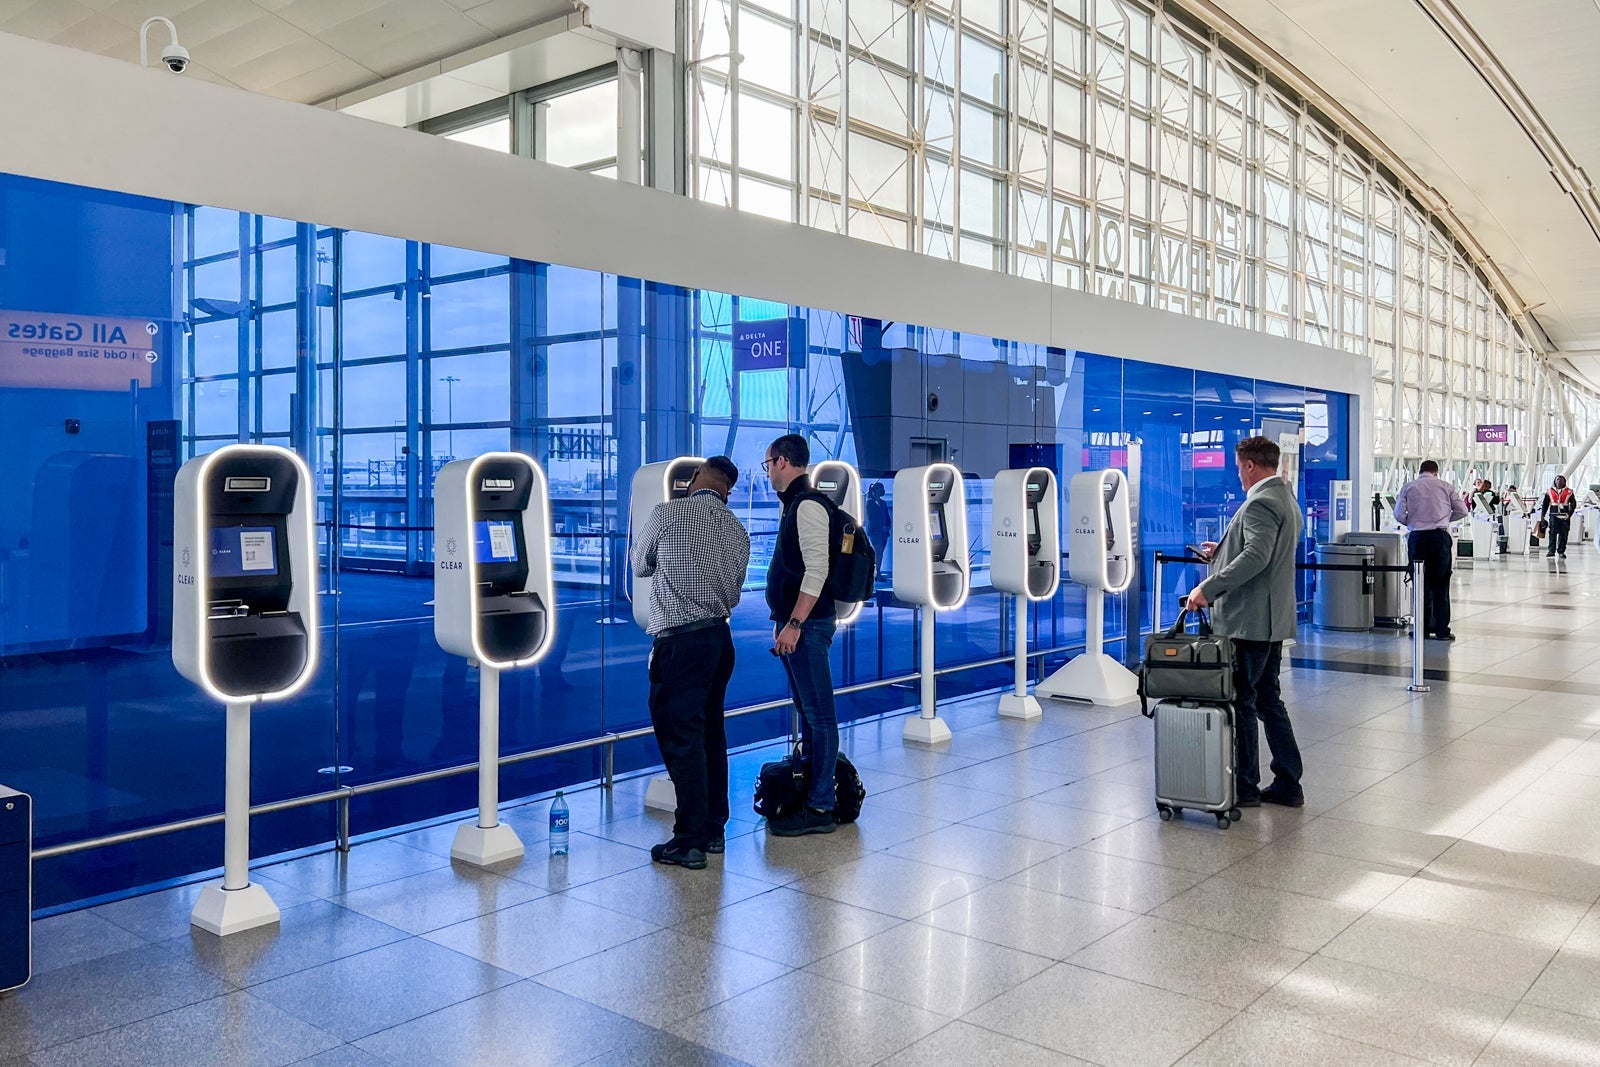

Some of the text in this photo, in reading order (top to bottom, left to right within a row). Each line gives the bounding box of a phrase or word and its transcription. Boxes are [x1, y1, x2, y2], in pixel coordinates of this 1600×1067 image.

[745, 332, 766, 340] DELTA
[751, 340, 782, 358] ONE
[1485, 431, 1504, 439] ONE
[440, 561, 463, 570] CLEAR
[177, 574, 195, 585] CLEAR
